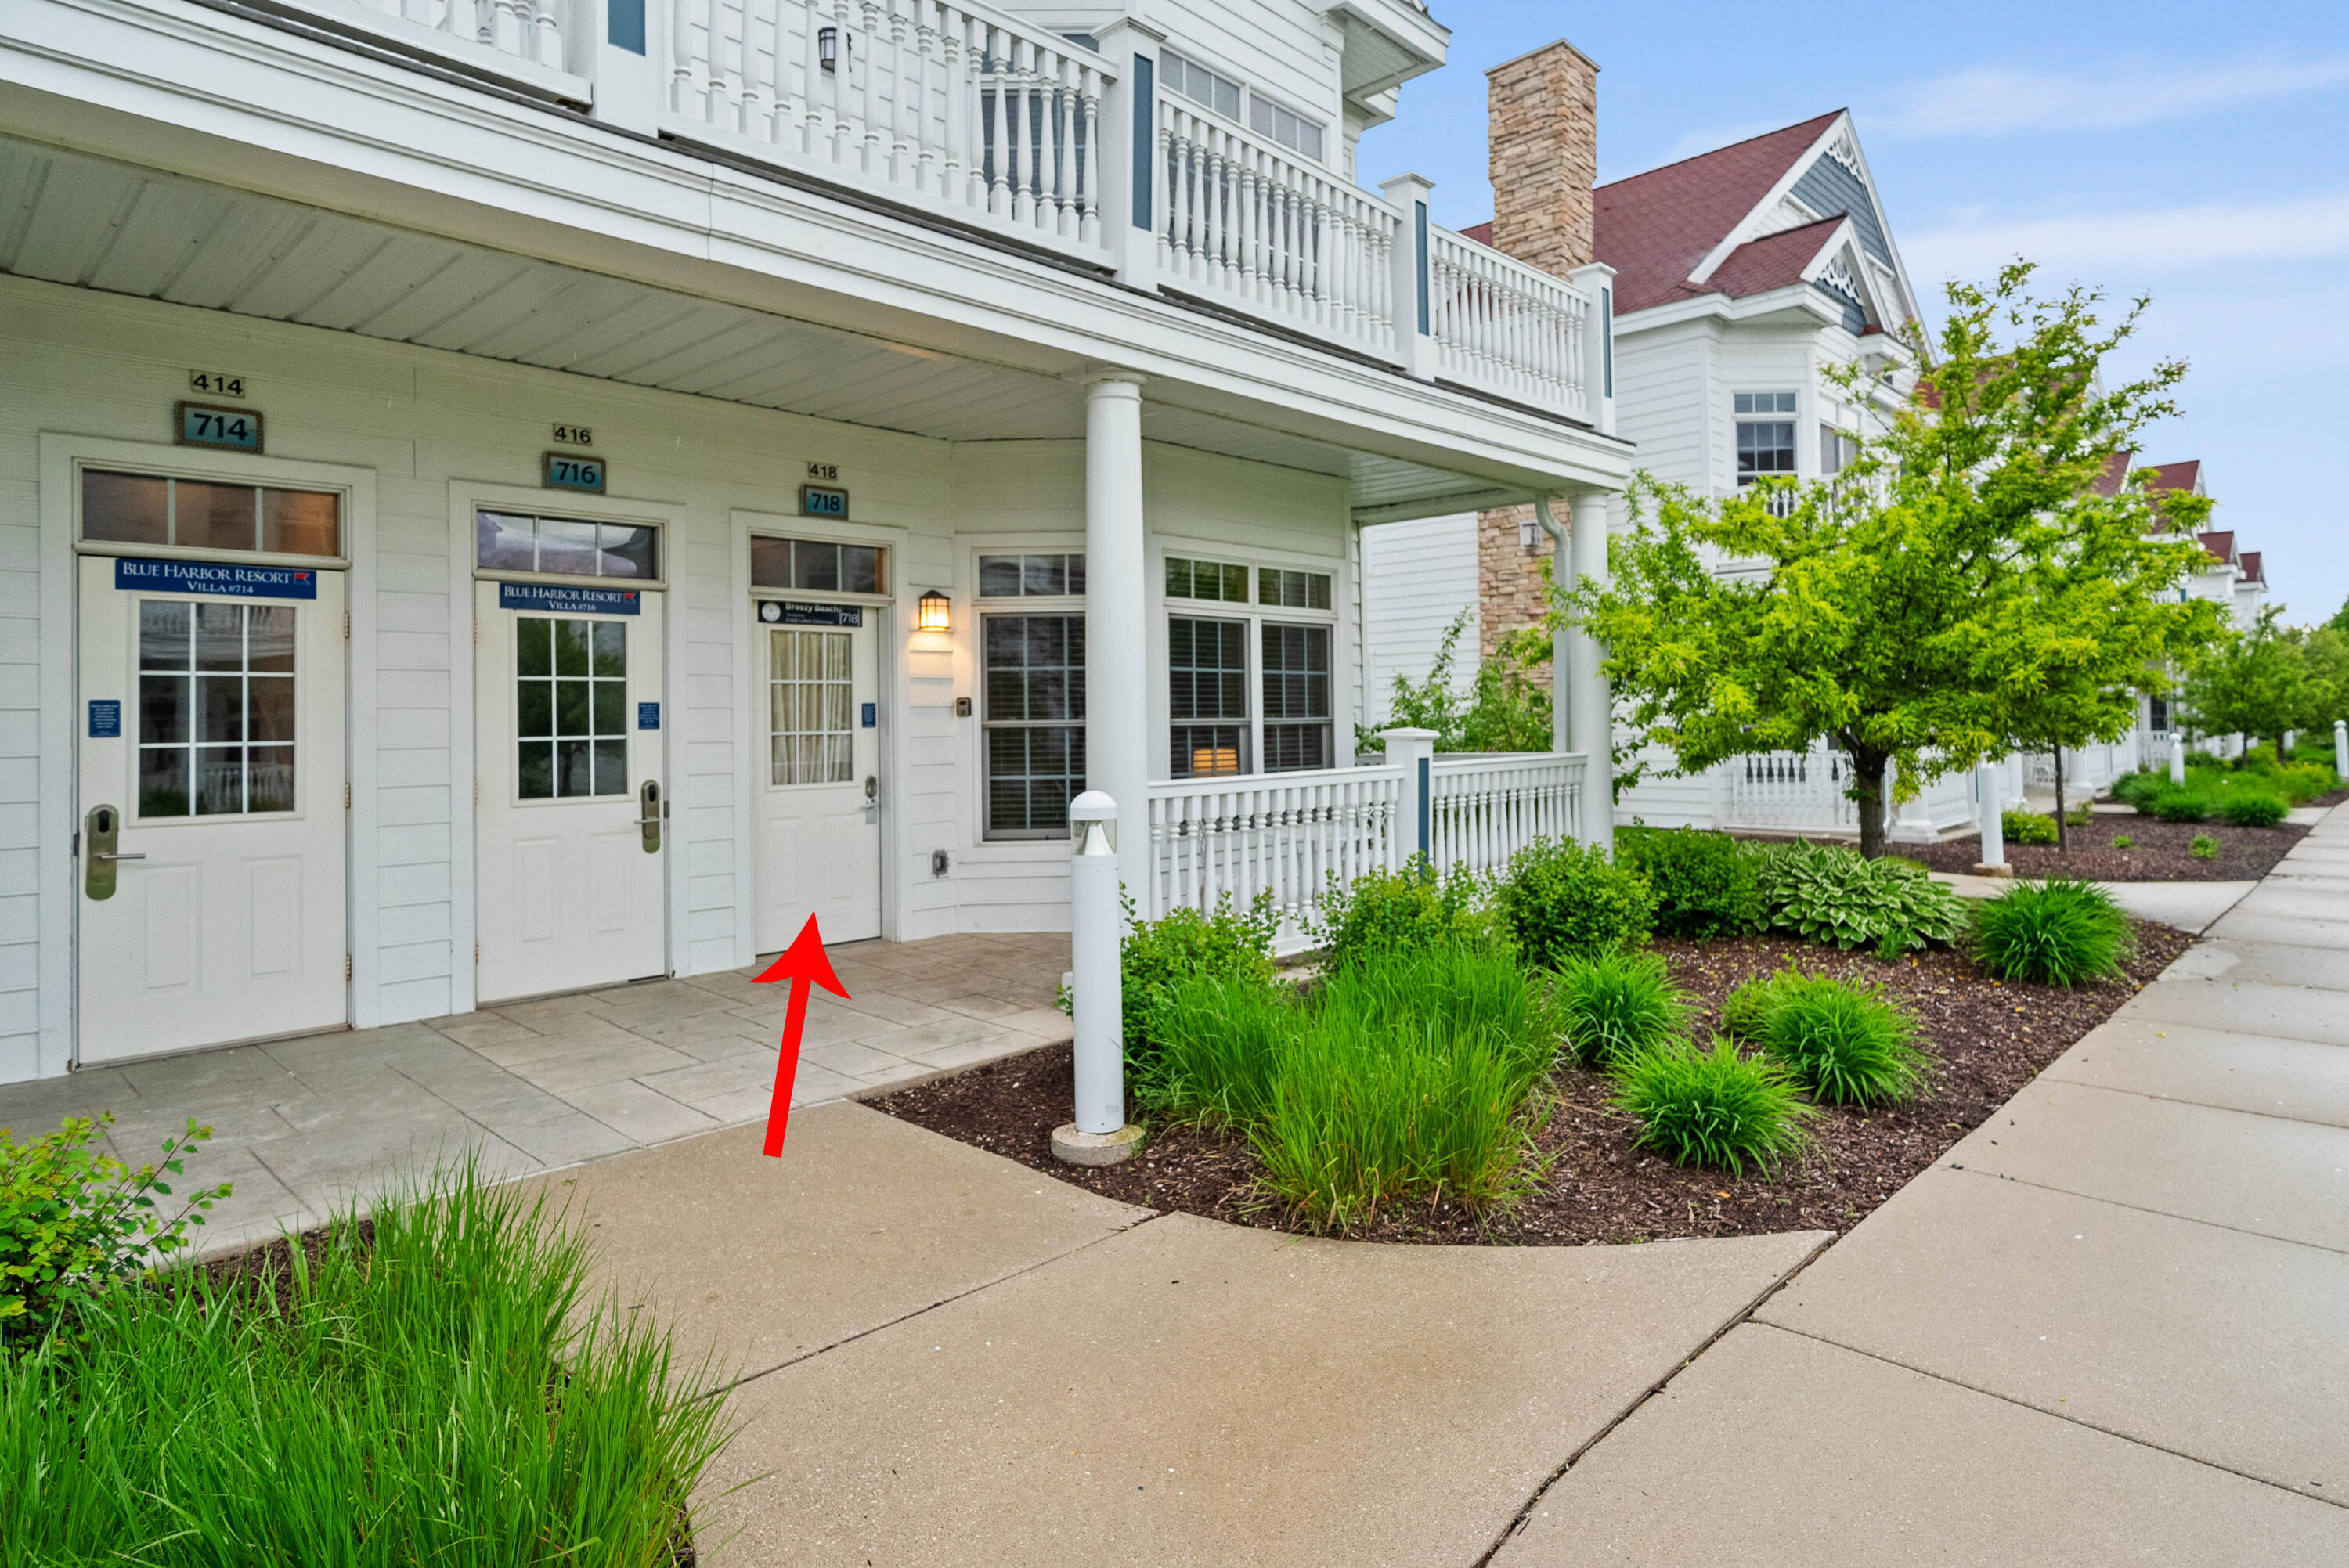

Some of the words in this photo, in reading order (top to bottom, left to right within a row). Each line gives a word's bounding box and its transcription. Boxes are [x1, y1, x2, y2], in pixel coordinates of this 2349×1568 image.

[193, 373, 244, 395] 414
[193, 413, 248, 441] 714
[554, 427, 591, 444] 416
[556, 461, 596, 484] 716
[809, 464, 837, 479] 418
[811, 492, 840, 512] 718
[122, 561, 161, 577] BLUE
[164, 564, 233, 582] HARBOR
[235, 570, 292, 584] RESORT
[187, 581, 226, 593] VILLA
[228, 584, 254, 594] #714
[504, 585, 530, 598] BLUE
[532, 587, 579, 600] HARBOR
[583, 591, 622, 603] RESORT
[549, 600, 577, 611] VILLA
[785, 601, 814, 613] Breezy
[814, 604, 839, 614] Beach
